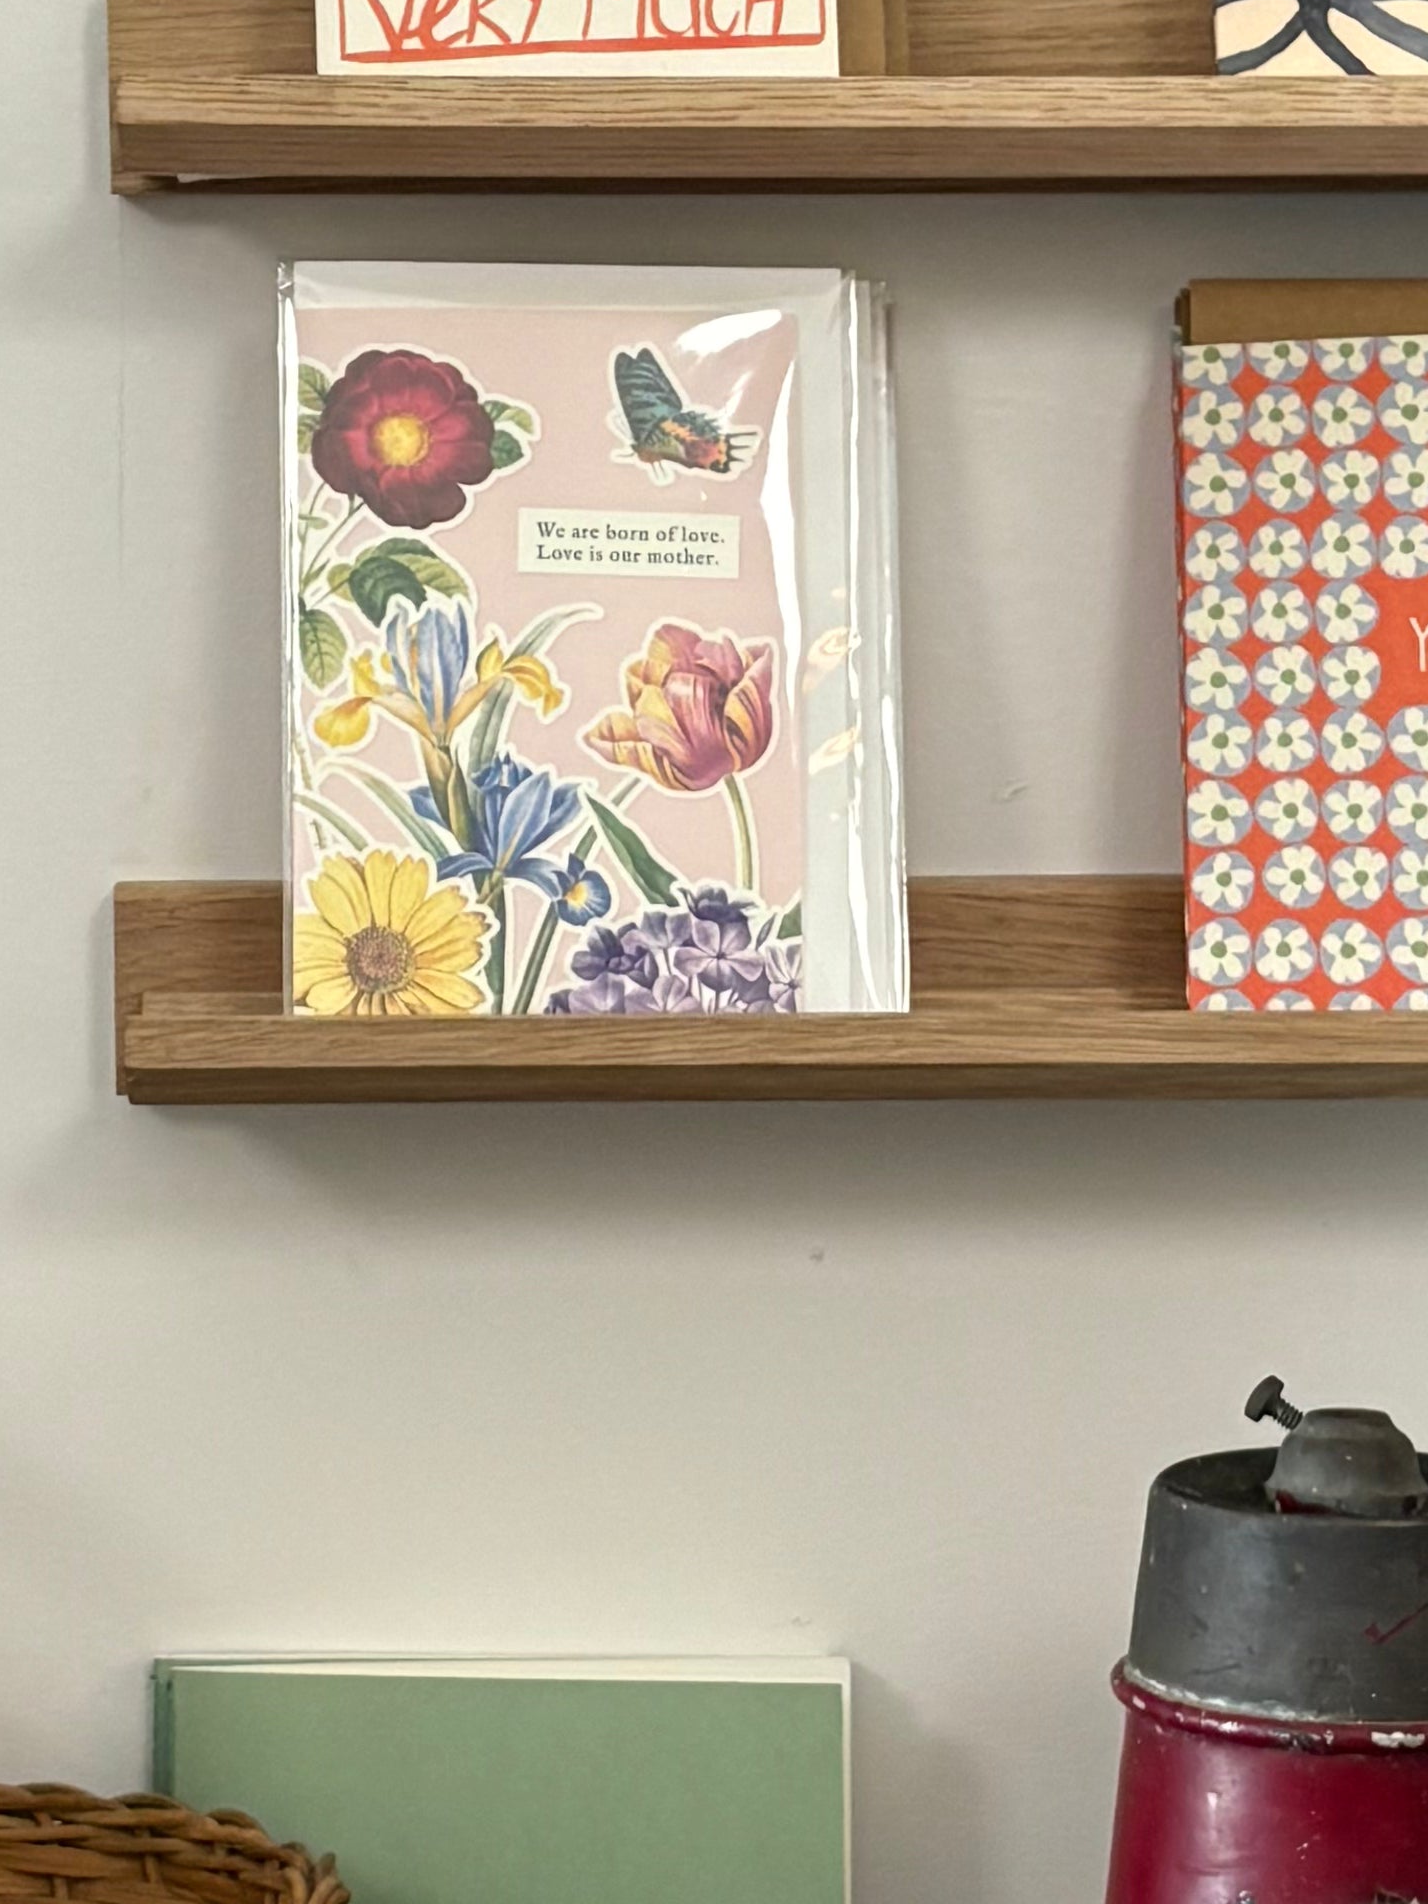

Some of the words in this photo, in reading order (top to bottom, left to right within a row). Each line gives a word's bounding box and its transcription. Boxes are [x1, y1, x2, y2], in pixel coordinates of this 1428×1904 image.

[537, 521, 565, 538] We
[571, 527, 600, 539] are
[606, 524, 649, 541] born
[656, 525, 679, 542] of
[681, 526, 726, 543] love.
[536, 545, 583, 561] Love
[589, 546, 603, 562] is
[609, 549, 642, 563] our
[647, 547, 720, 566] mother.
